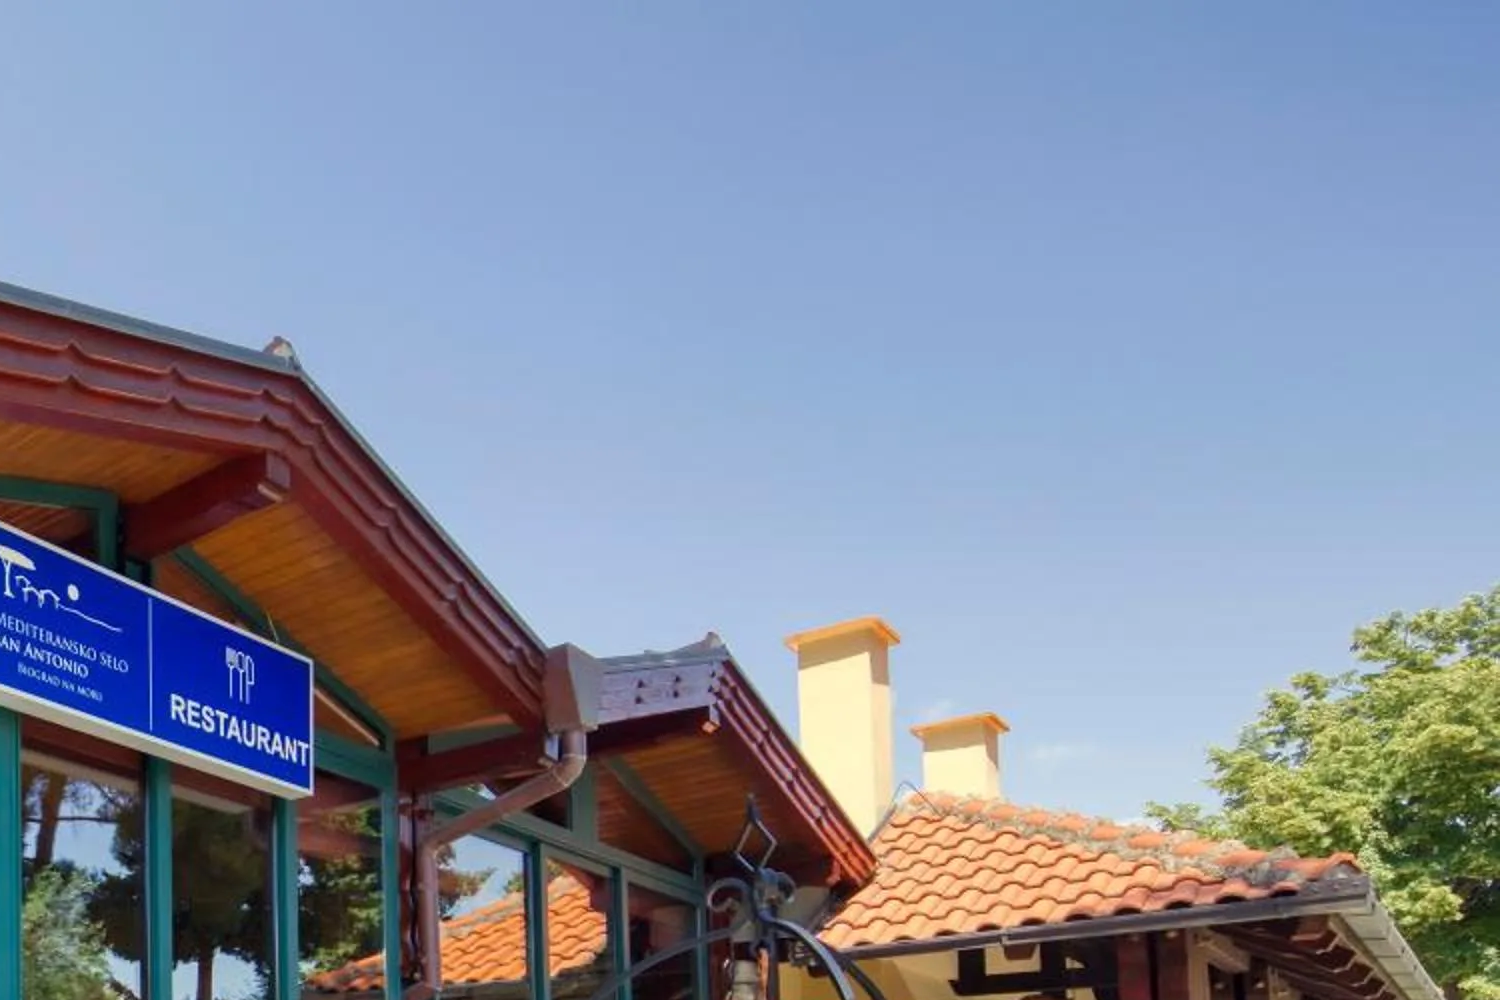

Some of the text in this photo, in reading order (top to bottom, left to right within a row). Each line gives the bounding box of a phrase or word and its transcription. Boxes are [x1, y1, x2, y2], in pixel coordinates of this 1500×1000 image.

[23, 641, 89, 679] ANTONIO
[100, 651, 129, 673] SELO
[170, 693, 309, 767] RESTAURANT
